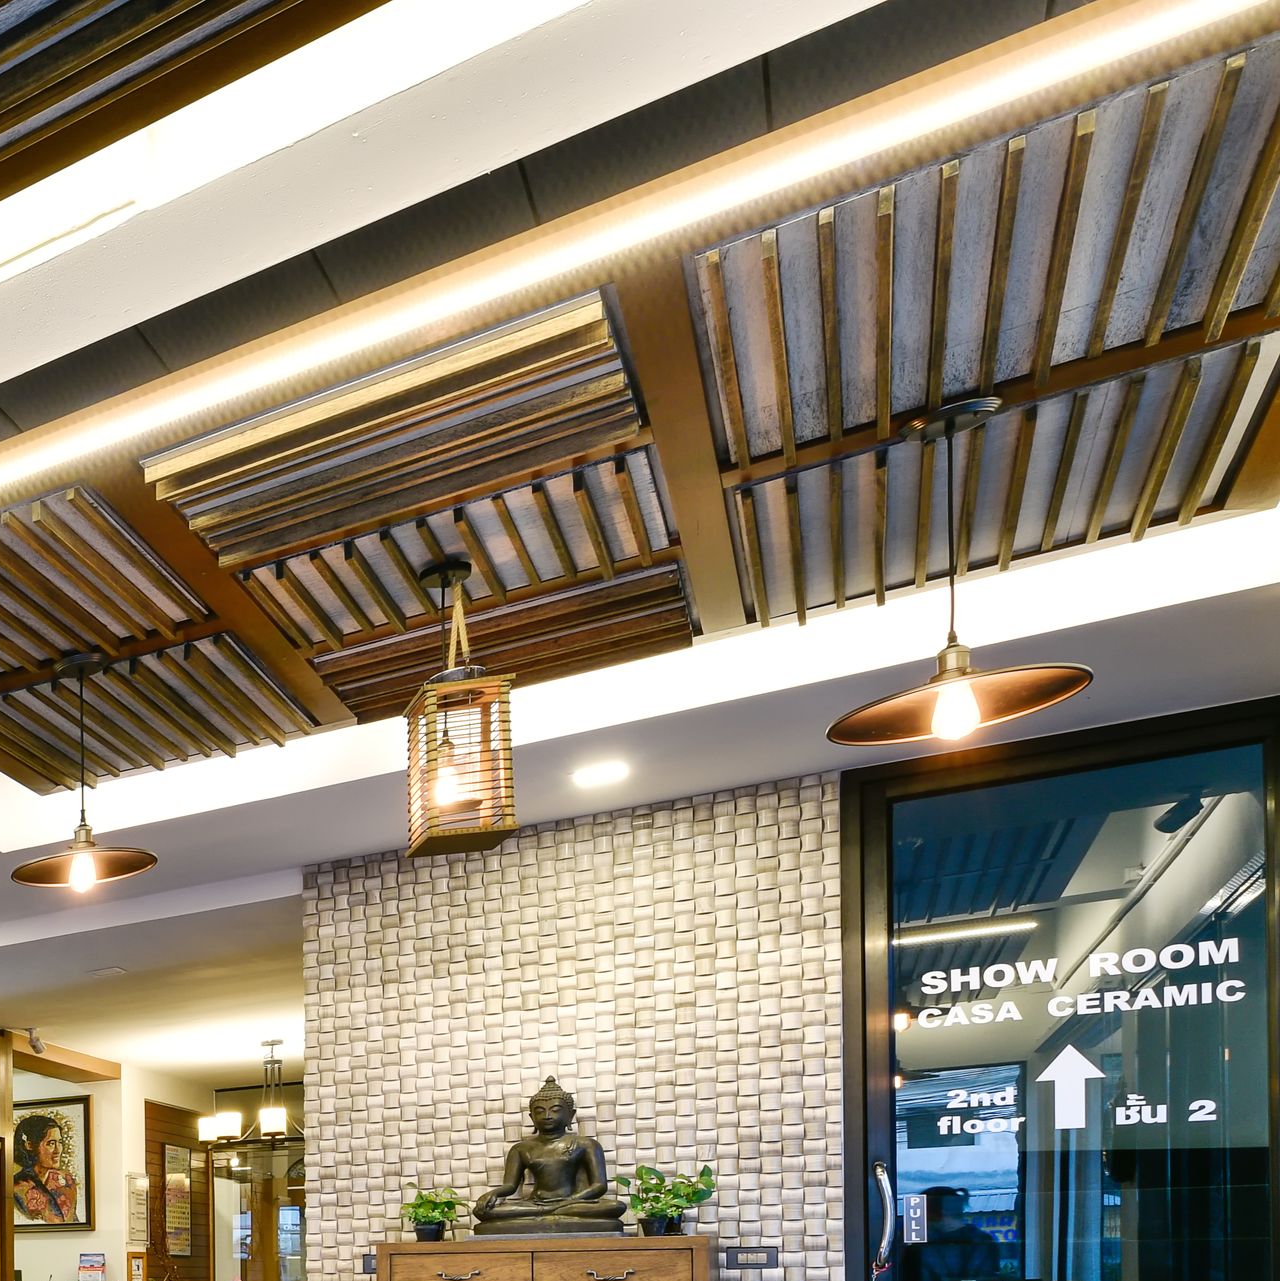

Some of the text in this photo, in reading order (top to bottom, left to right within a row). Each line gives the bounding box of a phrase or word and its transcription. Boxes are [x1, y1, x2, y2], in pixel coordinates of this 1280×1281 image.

[920, 937, 1240, 996] SHOW ROOM
[917, 979, 1247, 1030] CASA CERAMIC
[946, 1086, 1019, 1109] 2nd
[1115, 1093, 1168, 1127] ชั้น
[1187, 1099, 1218, 1122] 2
[936, 1114, 1027, 1136] floor
[909, 1197, 921, 1242] PULL
